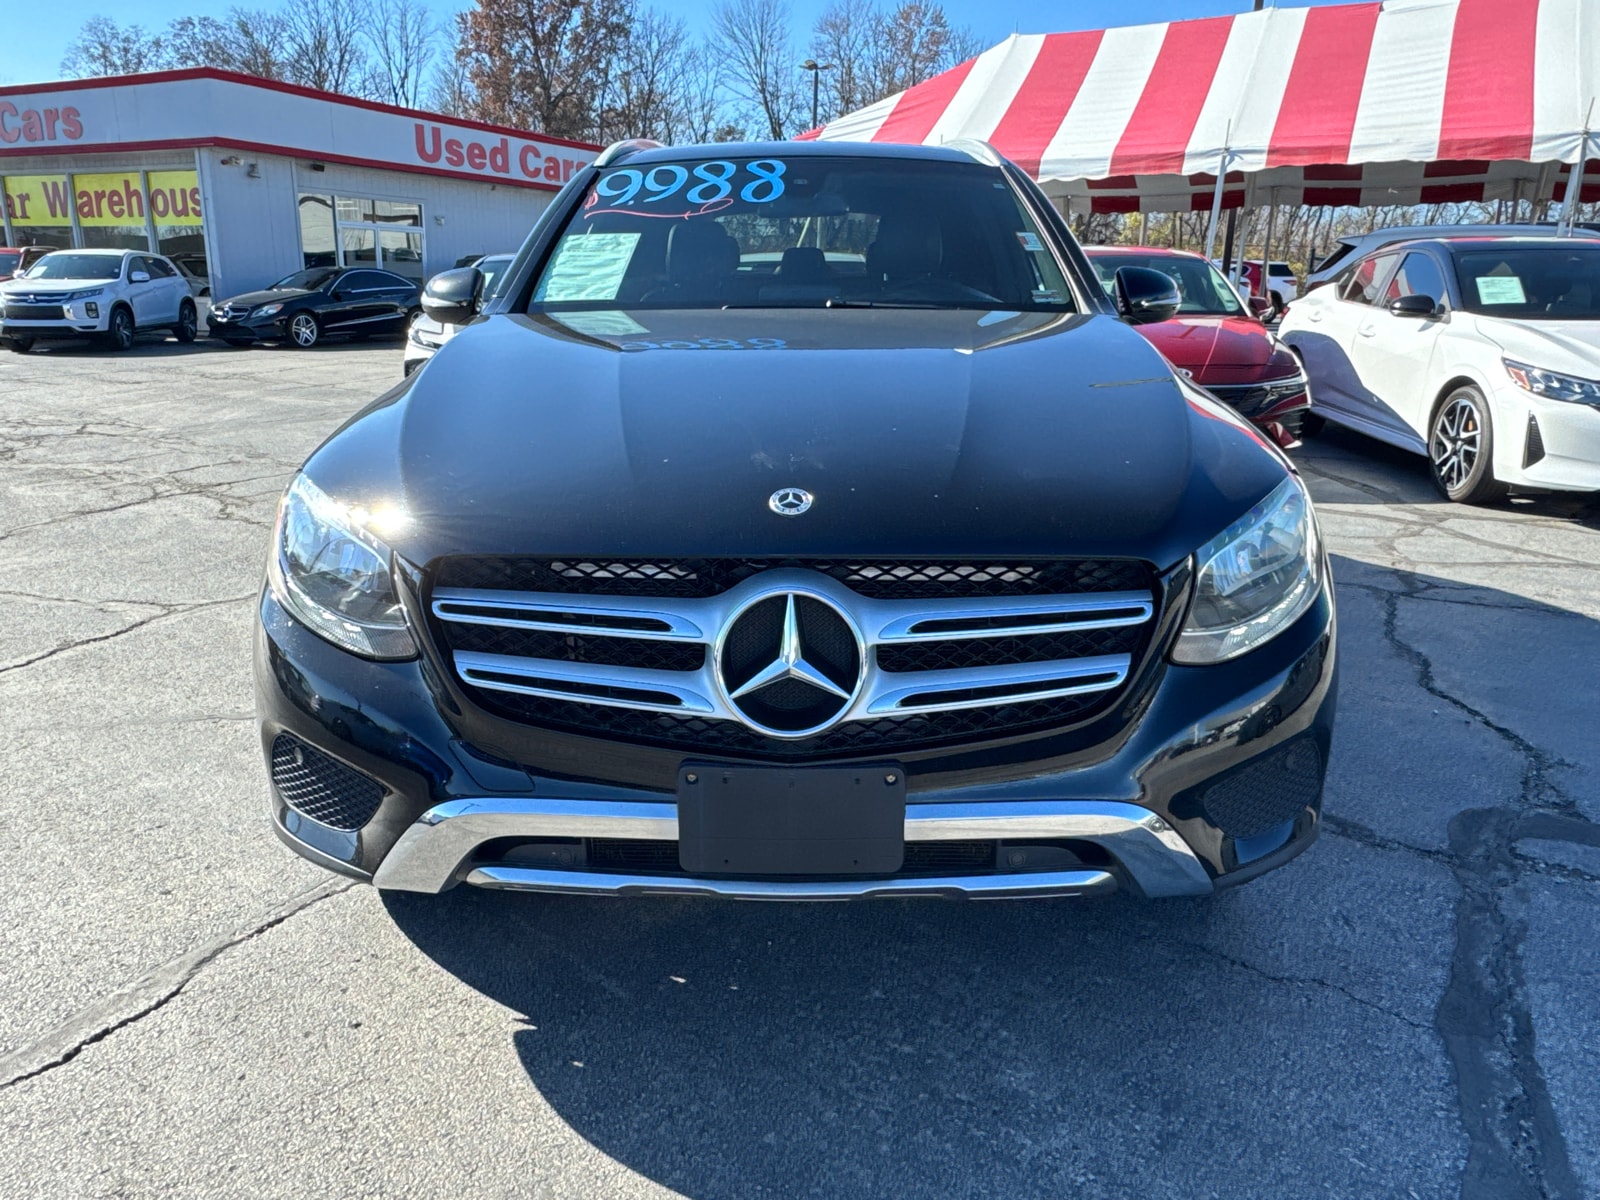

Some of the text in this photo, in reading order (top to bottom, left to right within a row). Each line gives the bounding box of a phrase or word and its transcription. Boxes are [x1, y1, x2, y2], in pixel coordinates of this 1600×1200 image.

[0, 101, 83, 143] Cars
[415, 124, 509, 173] Used
[0, 192, 31, 220] ar
